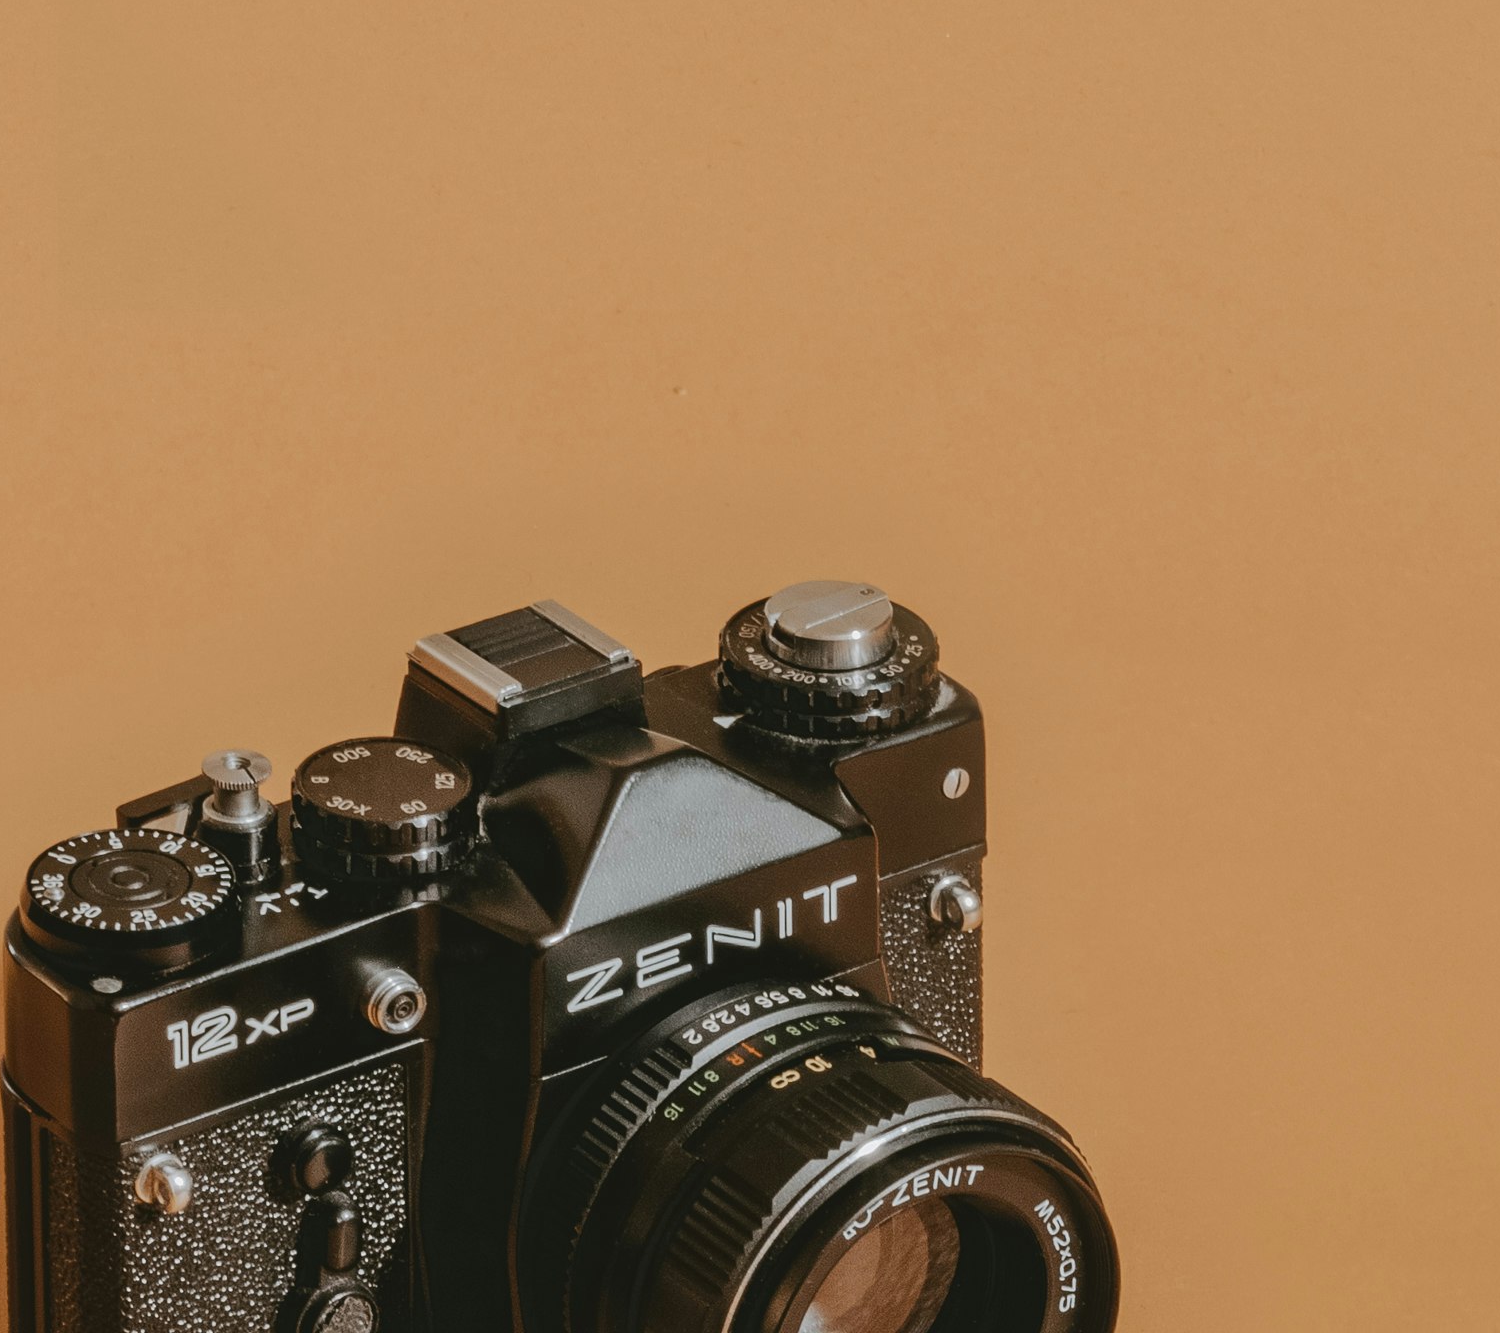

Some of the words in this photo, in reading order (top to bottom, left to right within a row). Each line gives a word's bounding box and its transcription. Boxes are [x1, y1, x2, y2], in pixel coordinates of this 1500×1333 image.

[749, 653, 775, 670] 400
[782, 670, 816, 684] 200
[879, 664, 904, 677] 50
[906, 644, 924, 657] 25
[333, 747, 371, 763] 500
[395, 747, 434, 764] 250
[311, 776, 330, 786] B
[435, 772, 455, 789] 125
[401, 798, 428, 815] 60
[159, 841, 179, 854] 10
[181, 892, 207, 909] 20
[73, 901, 103, 918] 30
[131, 908, 158, 923] 25
[566, 873, 858, 1014] ZENIT
[755, 990, 790, 1008] 5,6
[788, 986, 807, 999] 8
[734, 1002, 751, 1016] 4
[702, 1009, 737, 1033] 2,8
[167, 1003, 240, 1070] 12
[245, 998, 316, 1045] XP
[682, 1028, 704, 1045] 2
[805, 1054, 833, 1072] 10
[892, 1165, 985, 1207] ZENIT
[1034, 1199, 1077, 1314] M52x0,75
